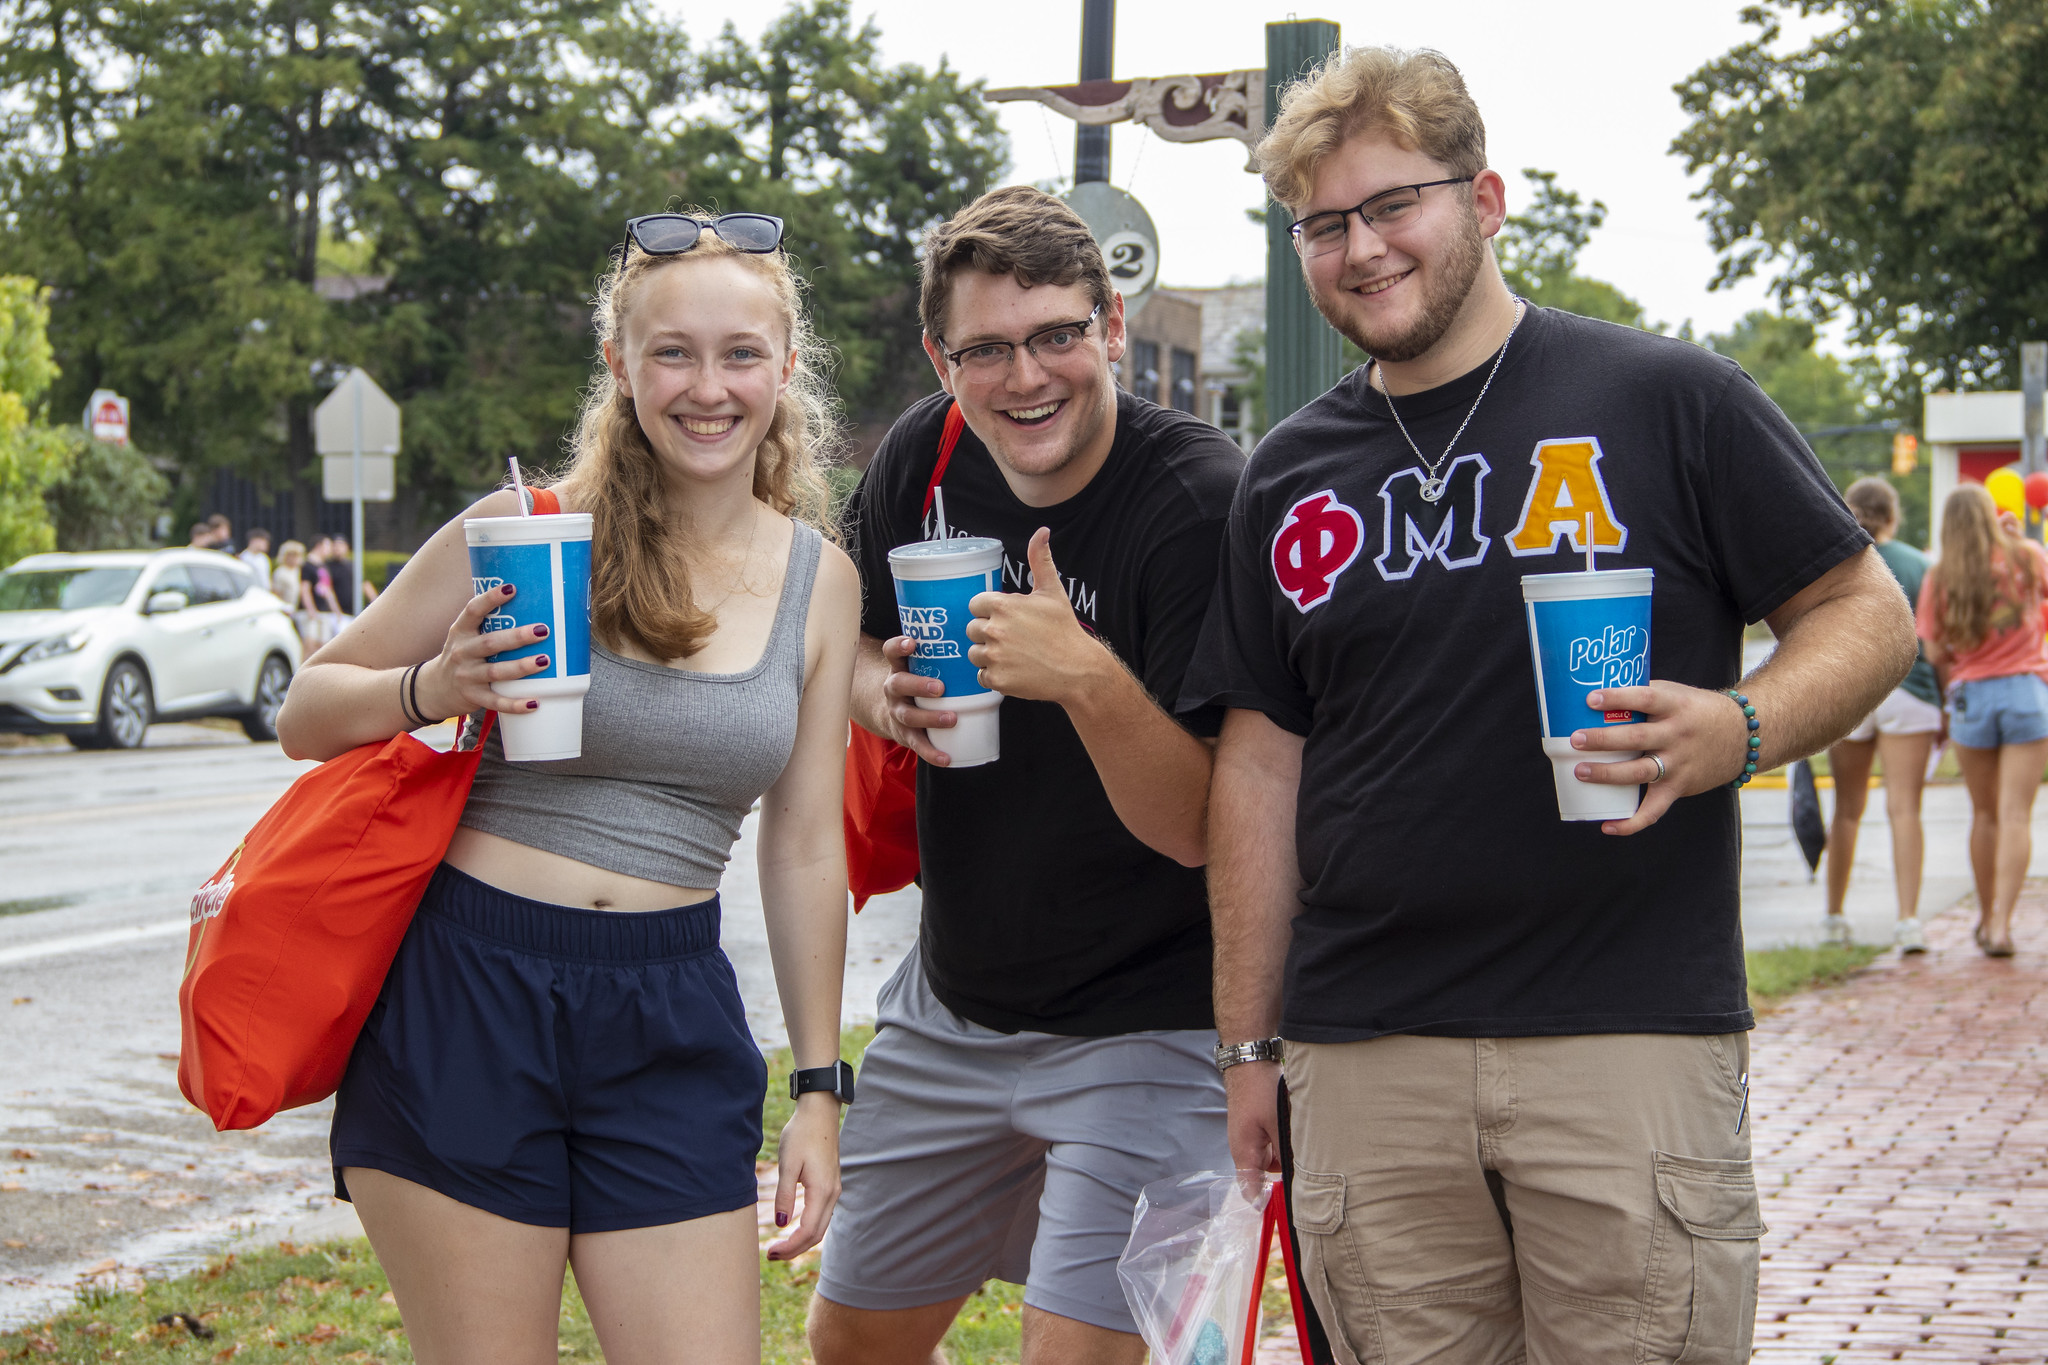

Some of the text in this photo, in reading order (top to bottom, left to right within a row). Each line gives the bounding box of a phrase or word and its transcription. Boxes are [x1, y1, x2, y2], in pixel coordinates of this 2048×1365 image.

[1109, 243, 1144, 279] 2
[899, 605, 947, 625] STAYS
[903, 624, 944, 640] COLD
[1570, 625, 1636, 672] Polar
[1601, 653, 1644, 689] Pop
